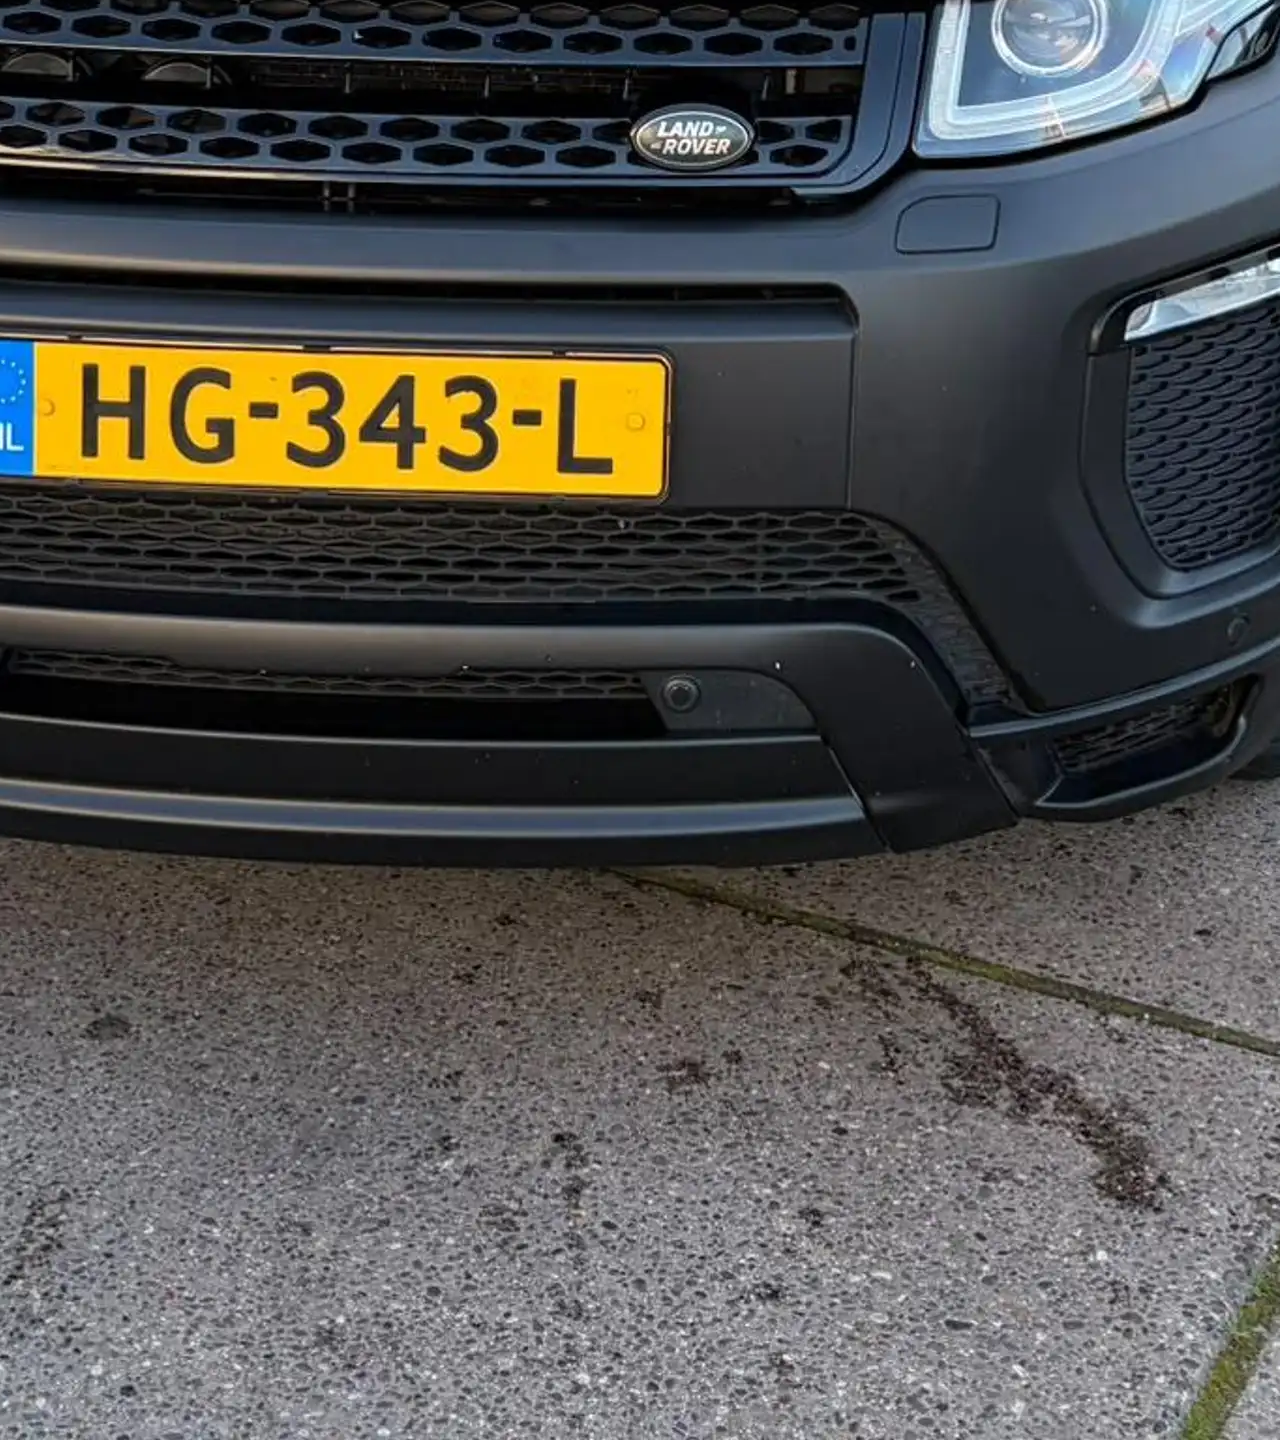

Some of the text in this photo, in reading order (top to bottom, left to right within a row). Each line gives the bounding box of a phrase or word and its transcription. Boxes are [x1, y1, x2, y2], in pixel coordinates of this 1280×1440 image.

[657, 120, 715, 138] LAND
[661, 138, 732, 156] ROVER
[80, 363, 614, 475] HG-343-L
